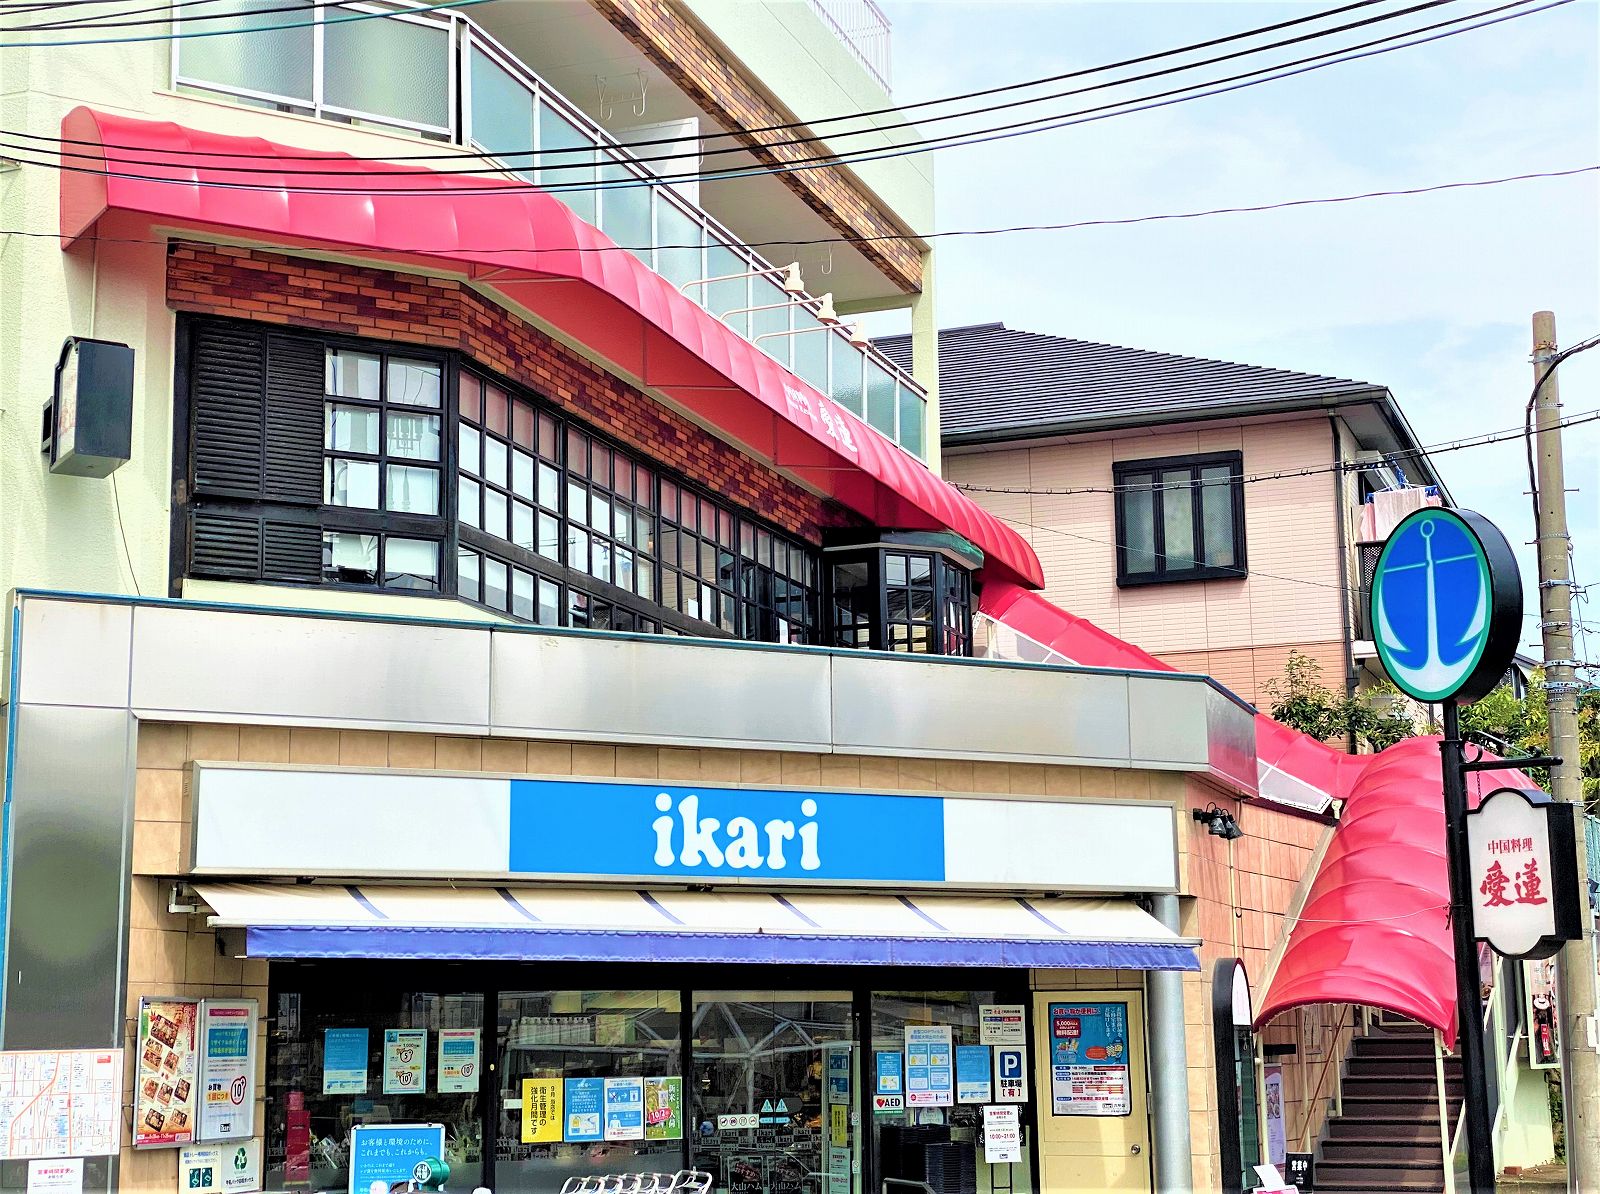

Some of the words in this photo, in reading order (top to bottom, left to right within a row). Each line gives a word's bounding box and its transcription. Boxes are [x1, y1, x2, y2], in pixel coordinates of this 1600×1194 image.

[652, 792, 821, 871] ikari
[1487, 837, 1533, 855] 中国料理
[1479, 857, 1548, 908] 愛蓮
[1004, 1054, 1018, 1076] P
[1000, 1079, 1022, 1088] 駐車場
[530, 1086, 538, 1135] 強化月間です
[539, 1086, 547, 1127] 衛生管理の
[884, 1098, 901, 1107] AED
